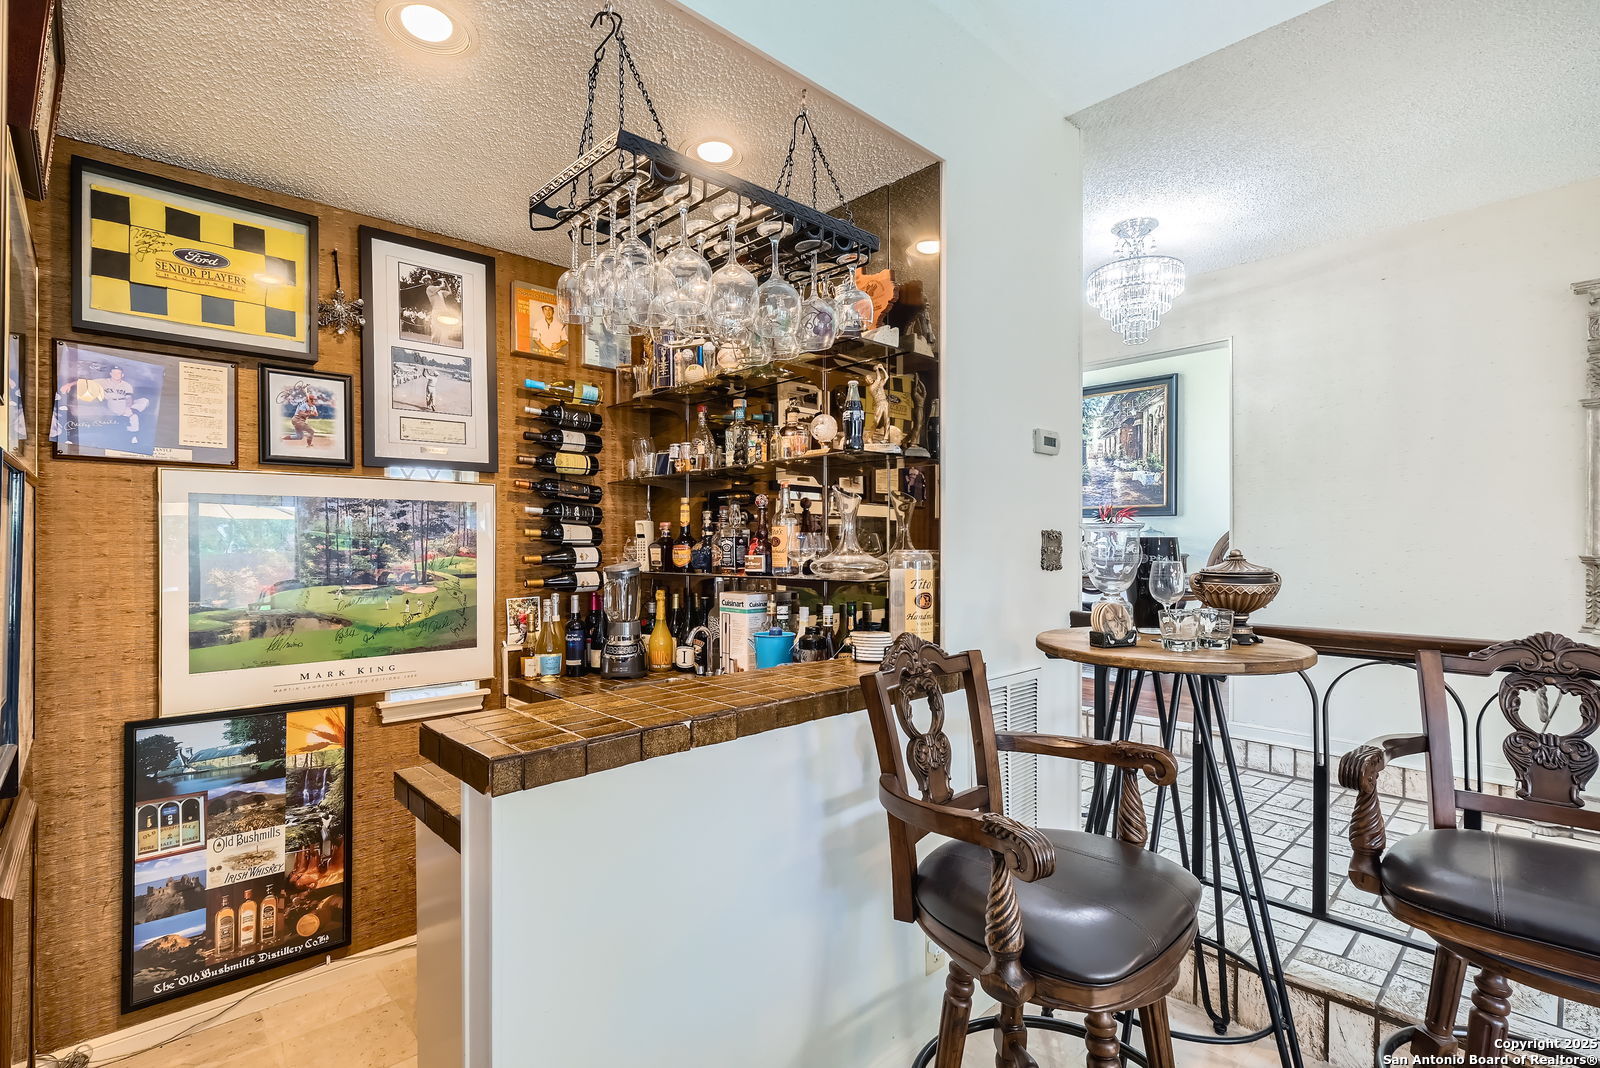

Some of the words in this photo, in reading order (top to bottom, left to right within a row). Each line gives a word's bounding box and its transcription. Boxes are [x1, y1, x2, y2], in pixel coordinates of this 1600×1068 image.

[184, 250, 219, 266] Ford
[155, 260, 197, 278] SENIOR
[201, 270, 247, 285] PLAYERS
[910, 578, 932, 590] Tito
[721, 599, 744, 608] Cuisinart
[300, 670, 345, 680] MARK
[357, 664, 396, 675] KING
[213, 836, 233, 853] Old
[236, 827, 281, 847] Bushmills
[224, 871, 248, 884] IRISH
[153, 982, 175, 994] The
[257, 944, 303, 963] Distillery
